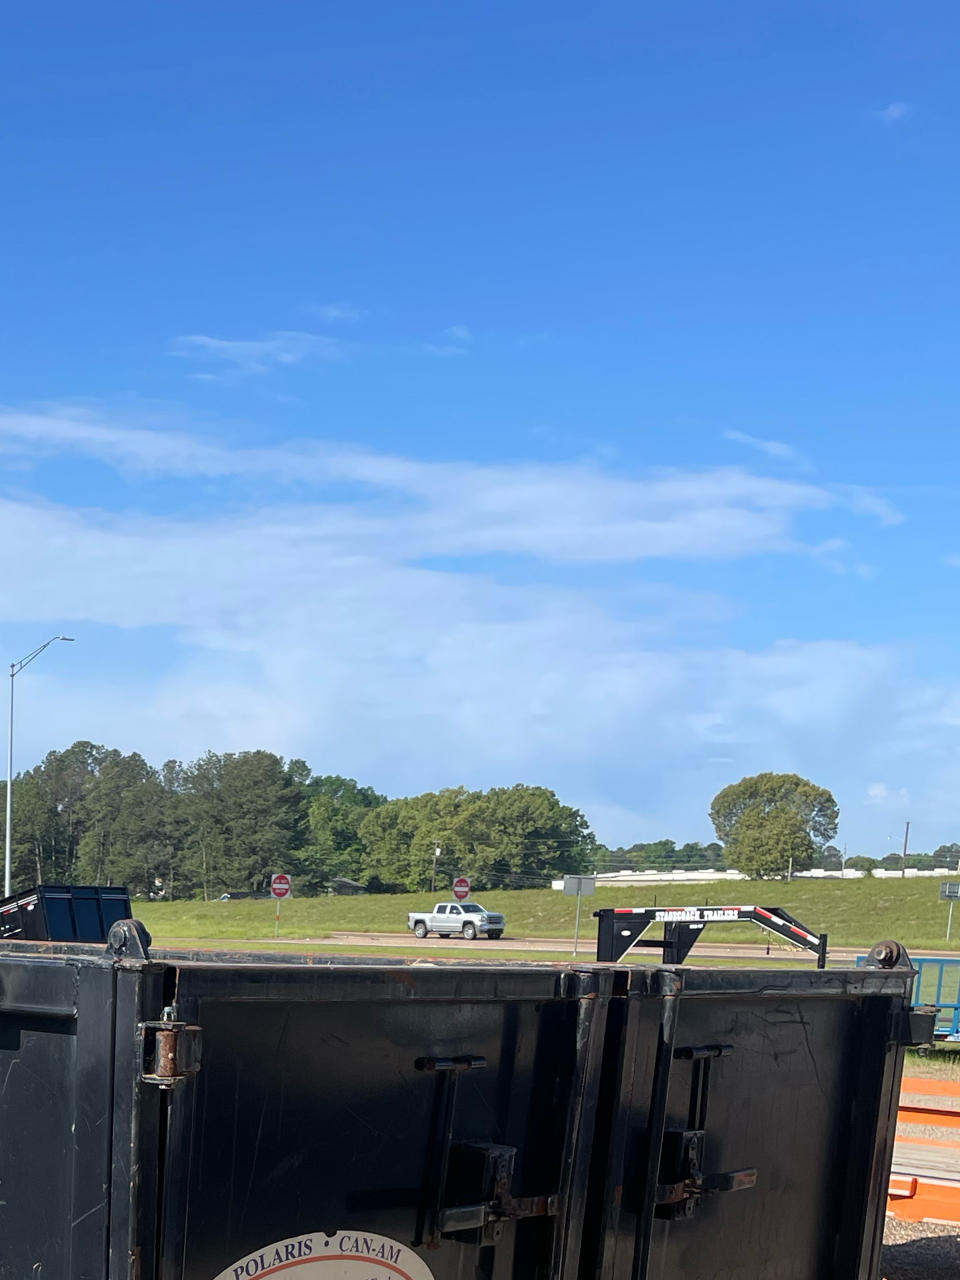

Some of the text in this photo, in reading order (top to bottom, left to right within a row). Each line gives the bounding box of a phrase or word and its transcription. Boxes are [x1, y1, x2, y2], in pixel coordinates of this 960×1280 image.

[655, 910, 739, 921] STAGECOACH TRAILERS
[339, 1235, 402, 1265] CAN-AM
